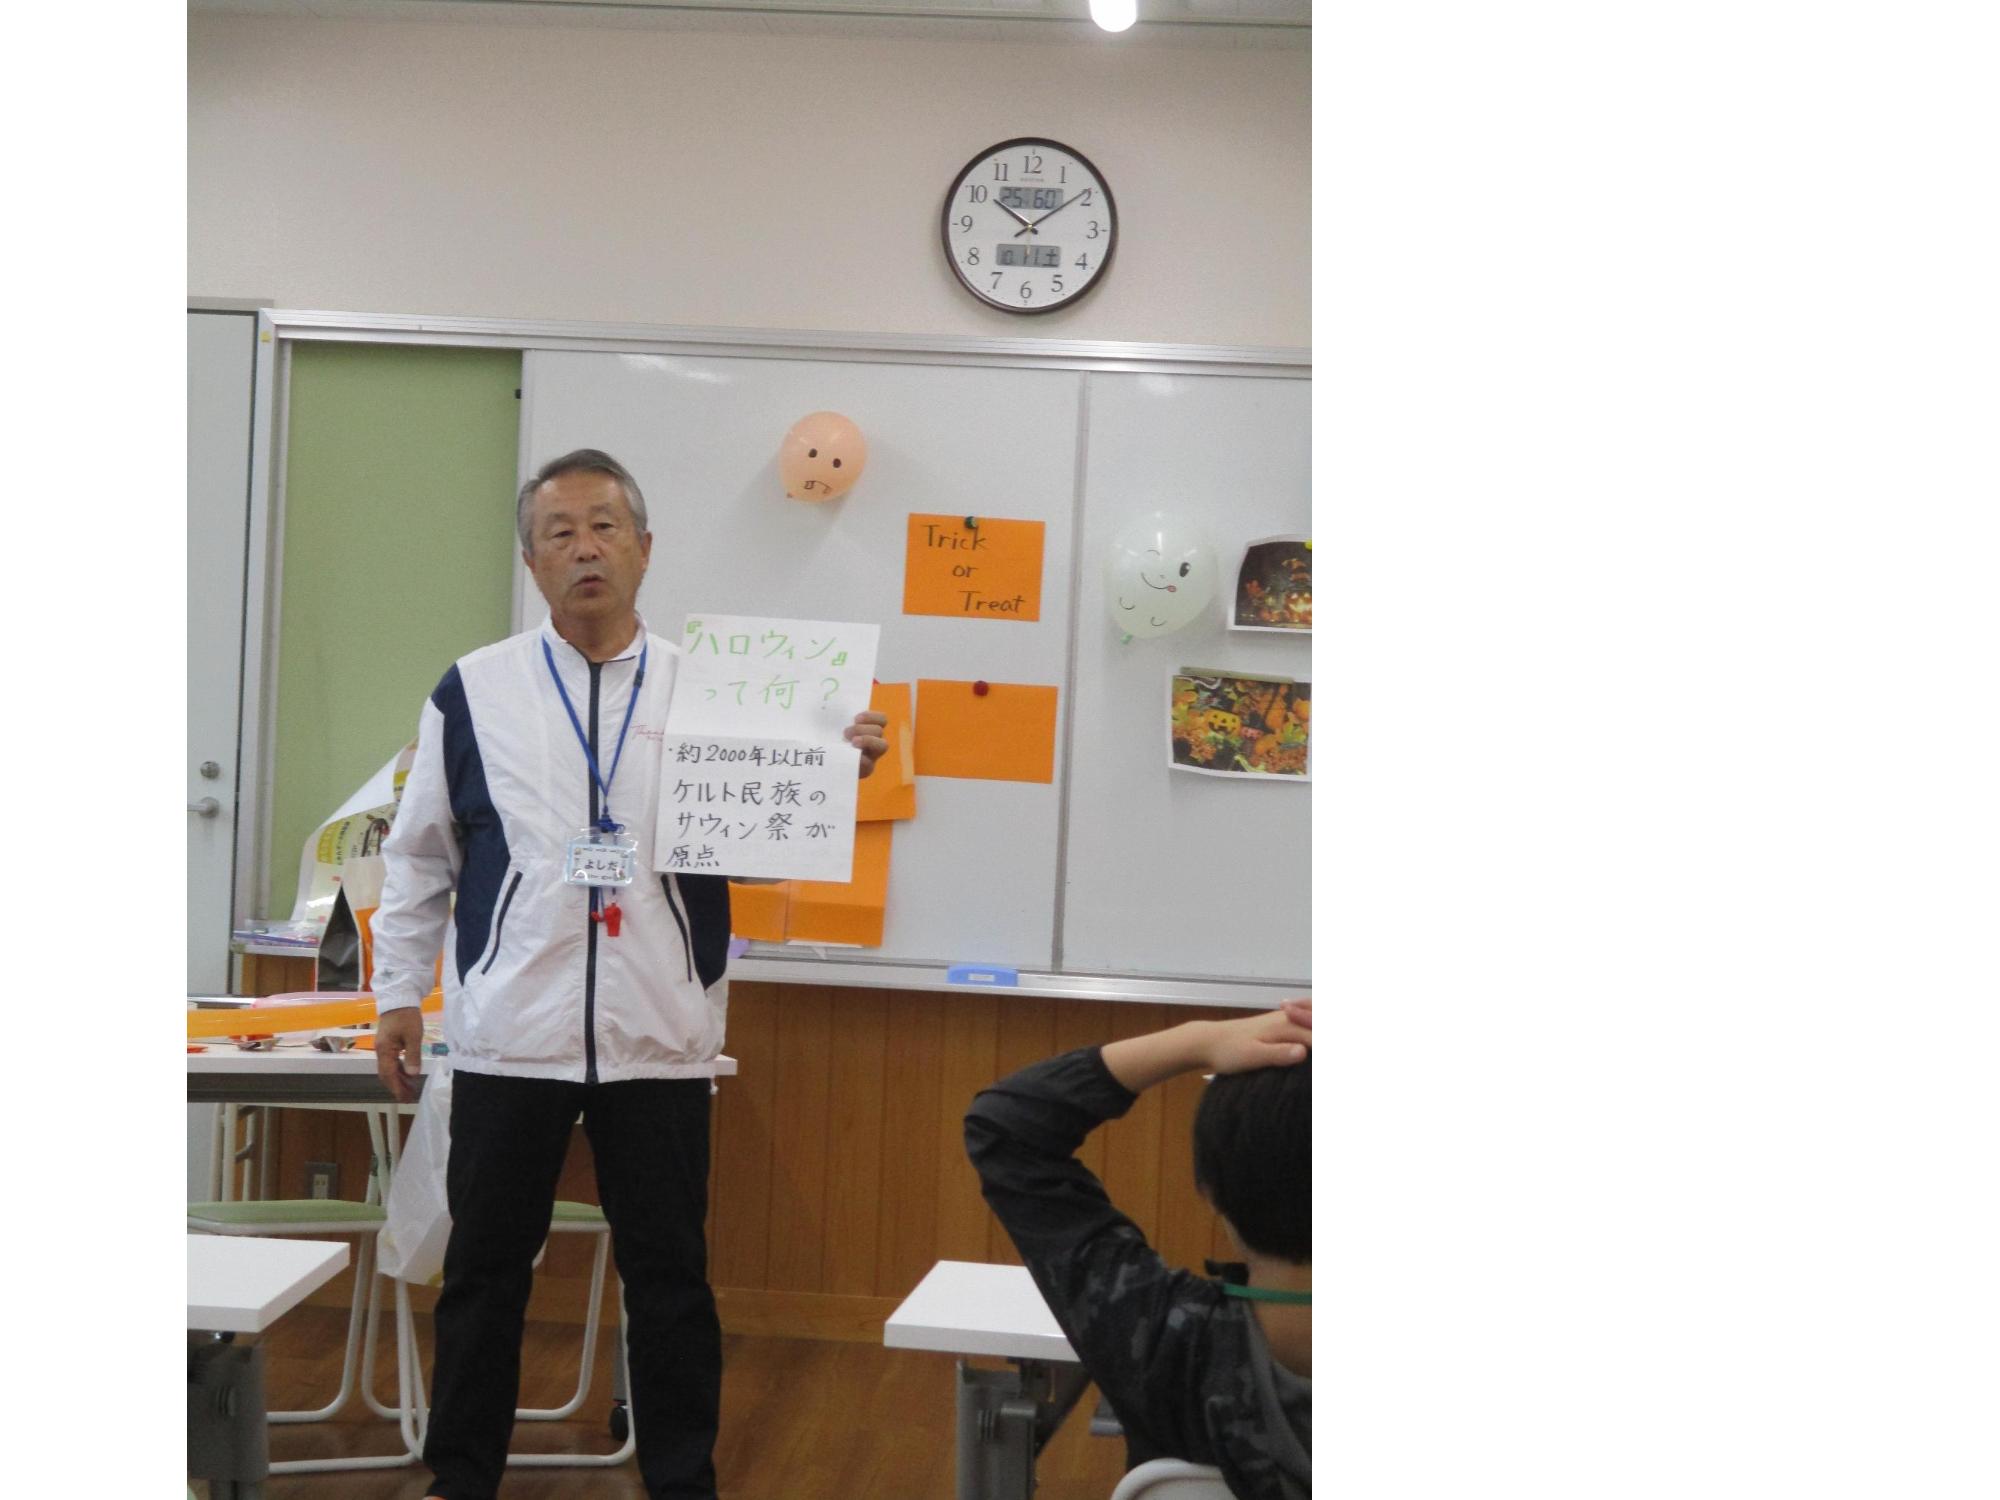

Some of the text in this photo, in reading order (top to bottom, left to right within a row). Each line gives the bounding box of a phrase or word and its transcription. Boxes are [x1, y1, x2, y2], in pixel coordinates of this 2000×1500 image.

[993, 162, 1009, 182] 11
[1023, 155, 1043, 174] 12
[1059, 166, 1067, 184] 1
[968, 184, 988, 203] 10
[1080, 188, 1093, 207] 2
[960, 215, 973, 233] 9
[1086, 220, 1099, 240] 3
[967, 247, 980, 266] 8
[1074, 252, 1088, 271] 4
[990, 271, 1003, 290] 7
[1020, 281, 1032, 299] 6
[1051, 274, 1063, 293] 5
[921, 524, 987, 550] Trick
[952, 564, 978, 578] or
[958, 590, 1025, 612] Treat
[672, 778, 828, 807] ケルト民族の
[675, 811, 836, 841] サウィン祭が
[584, 858, 618, 872] よしだ
[666, 843, 720, 868] 原点
